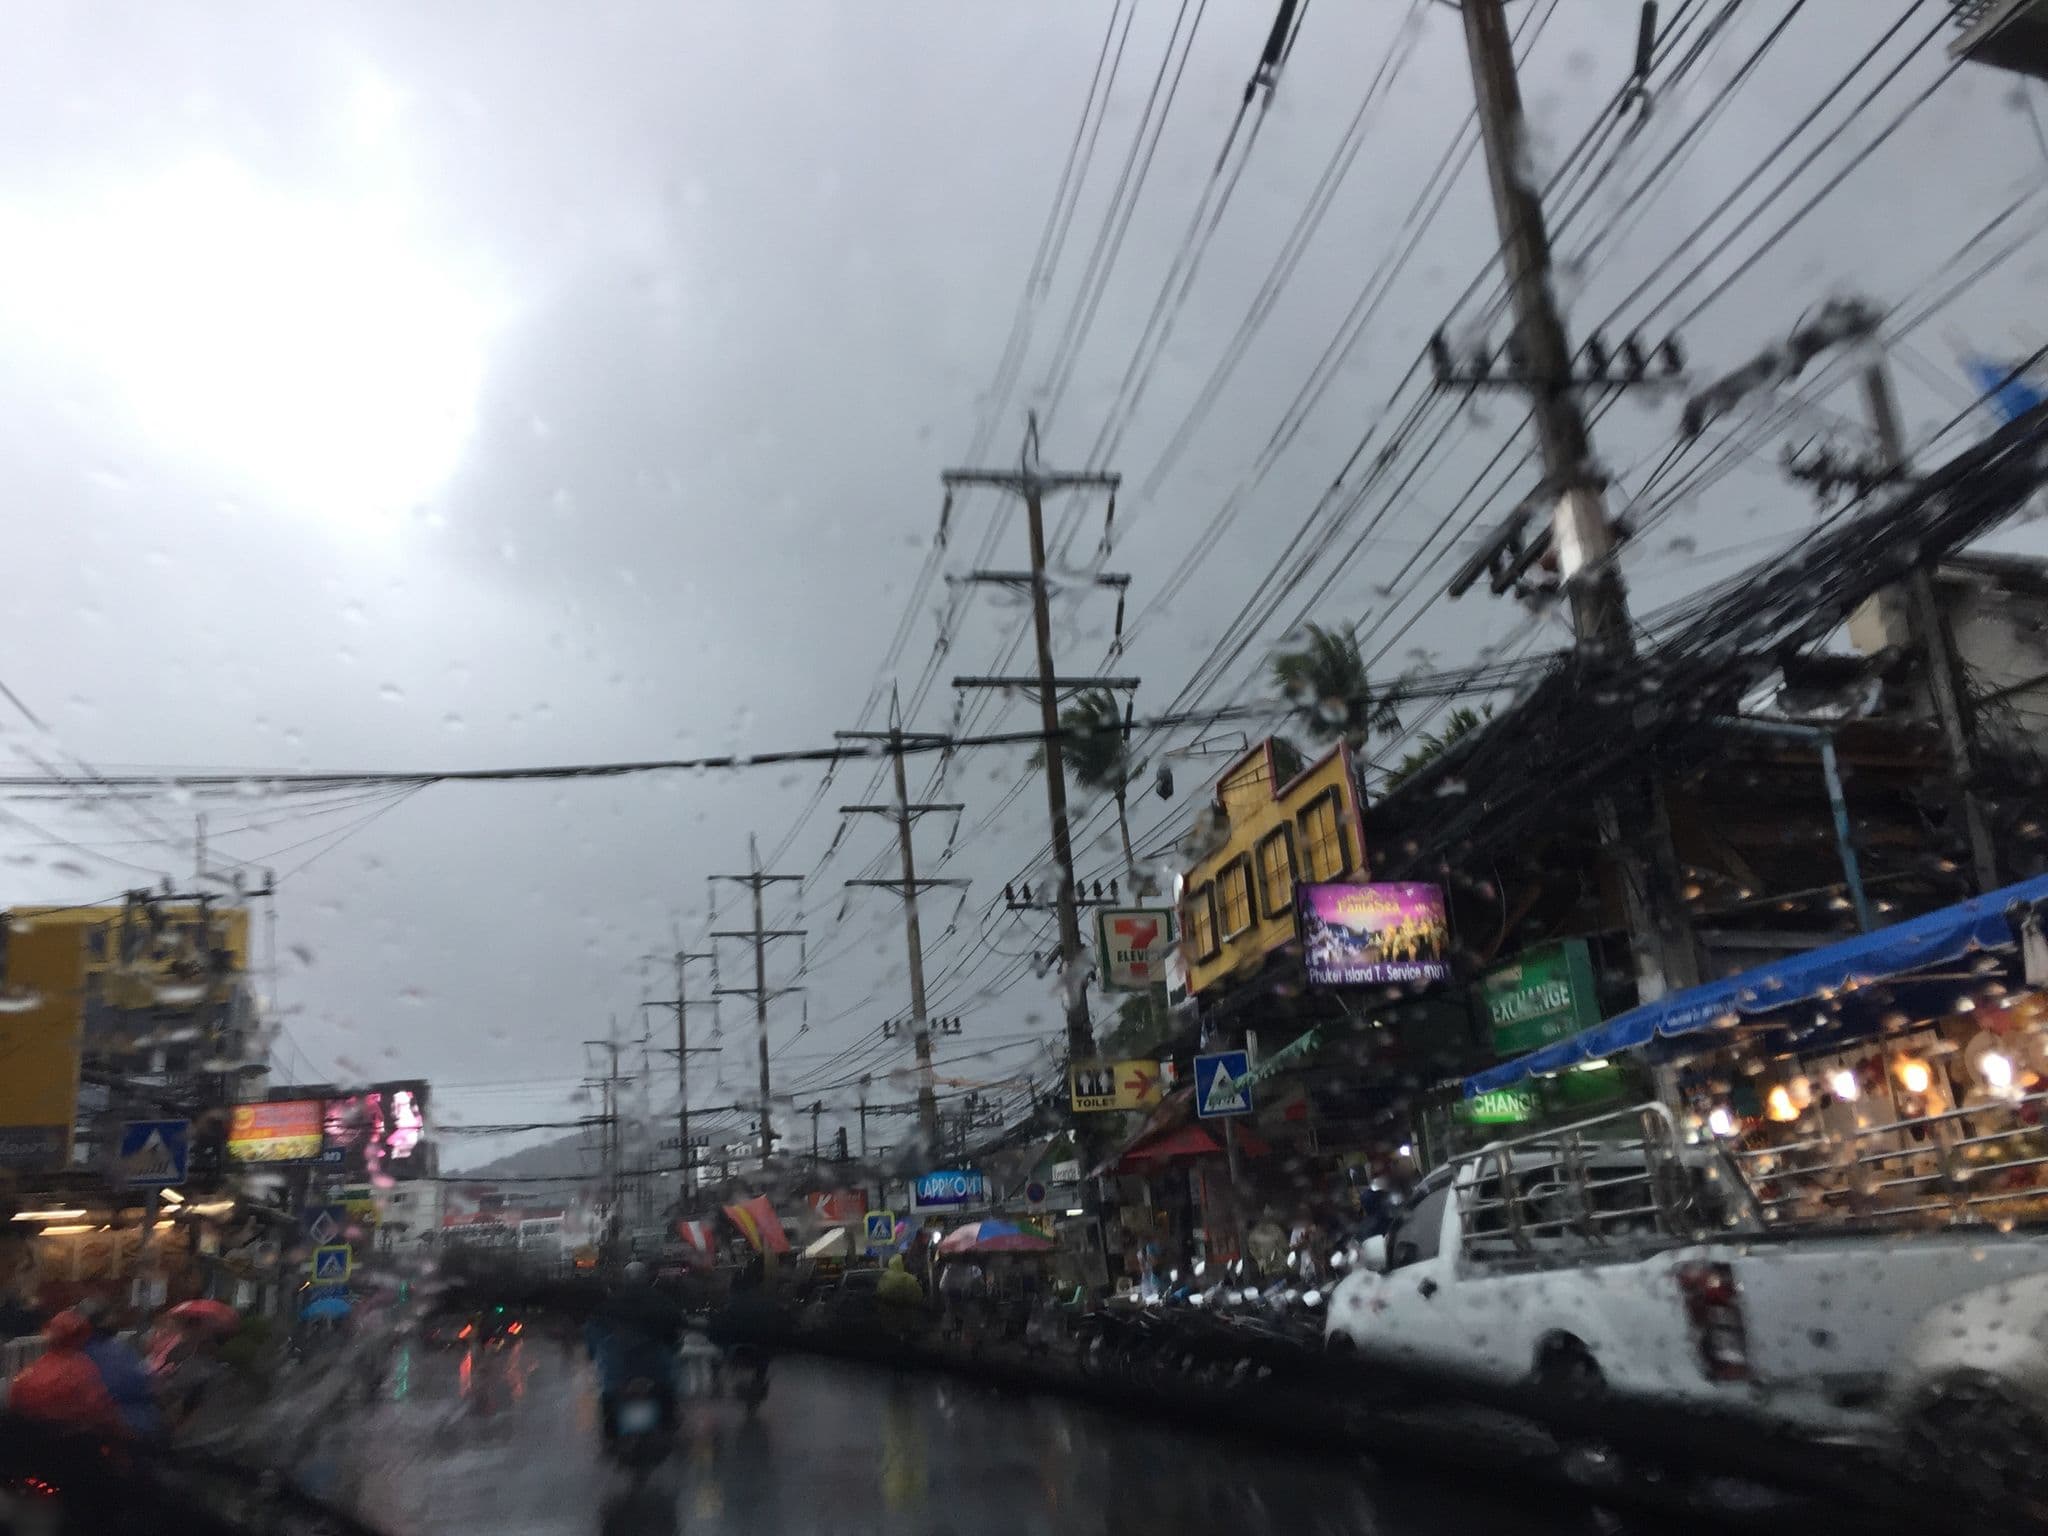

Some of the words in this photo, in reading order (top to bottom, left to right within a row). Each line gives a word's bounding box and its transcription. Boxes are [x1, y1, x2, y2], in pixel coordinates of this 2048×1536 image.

[1114, 919, 1159, 977] 7
[1345, 964, 1373, 982] Island
[1374, 966, 1385, 981] T.
[1387, 962, 1421, 981] Service
